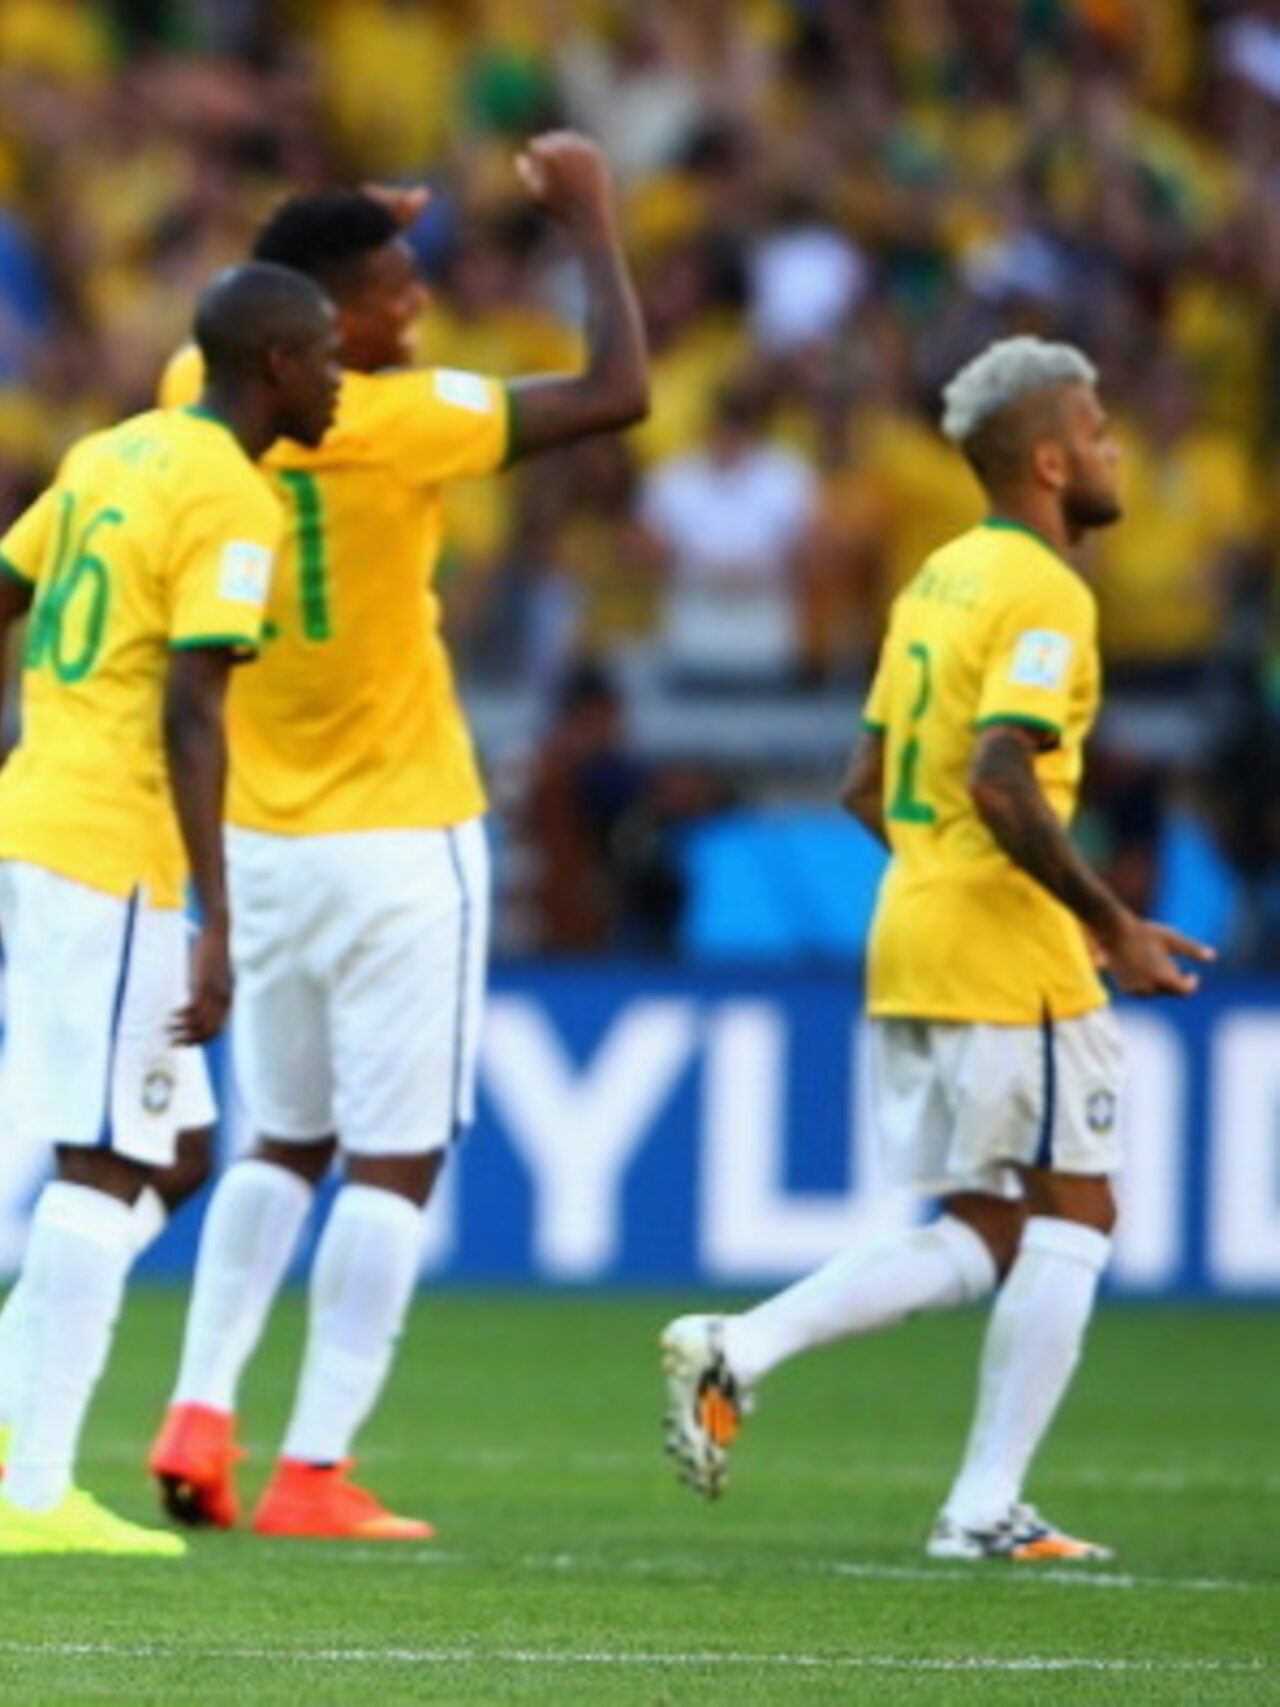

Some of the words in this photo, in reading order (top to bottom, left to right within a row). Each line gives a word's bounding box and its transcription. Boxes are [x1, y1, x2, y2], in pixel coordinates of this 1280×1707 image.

[25, 491, 124, 683] 16
[257, 468, 332, 640] 1
[884, 641, 939, 826] 2
